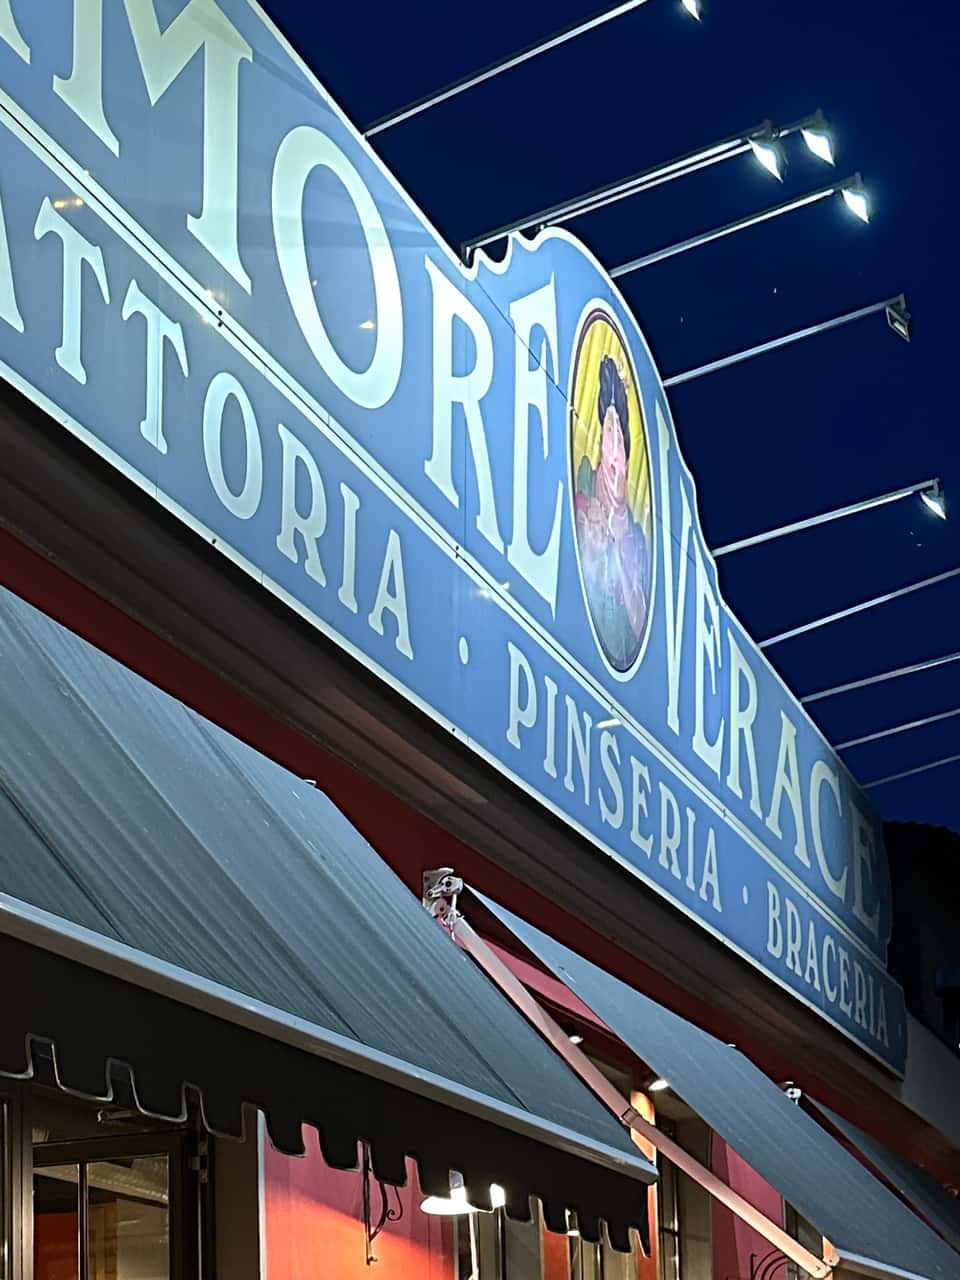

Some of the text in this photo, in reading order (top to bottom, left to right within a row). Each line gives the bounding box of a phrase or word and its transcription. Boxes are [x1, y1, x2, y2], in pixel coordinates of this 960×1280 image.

[506, 640, 722, 912] PINSERIA
[766, 880, 890, 1048] BRACERIA
[655, 398, 881, 938] VERACE
